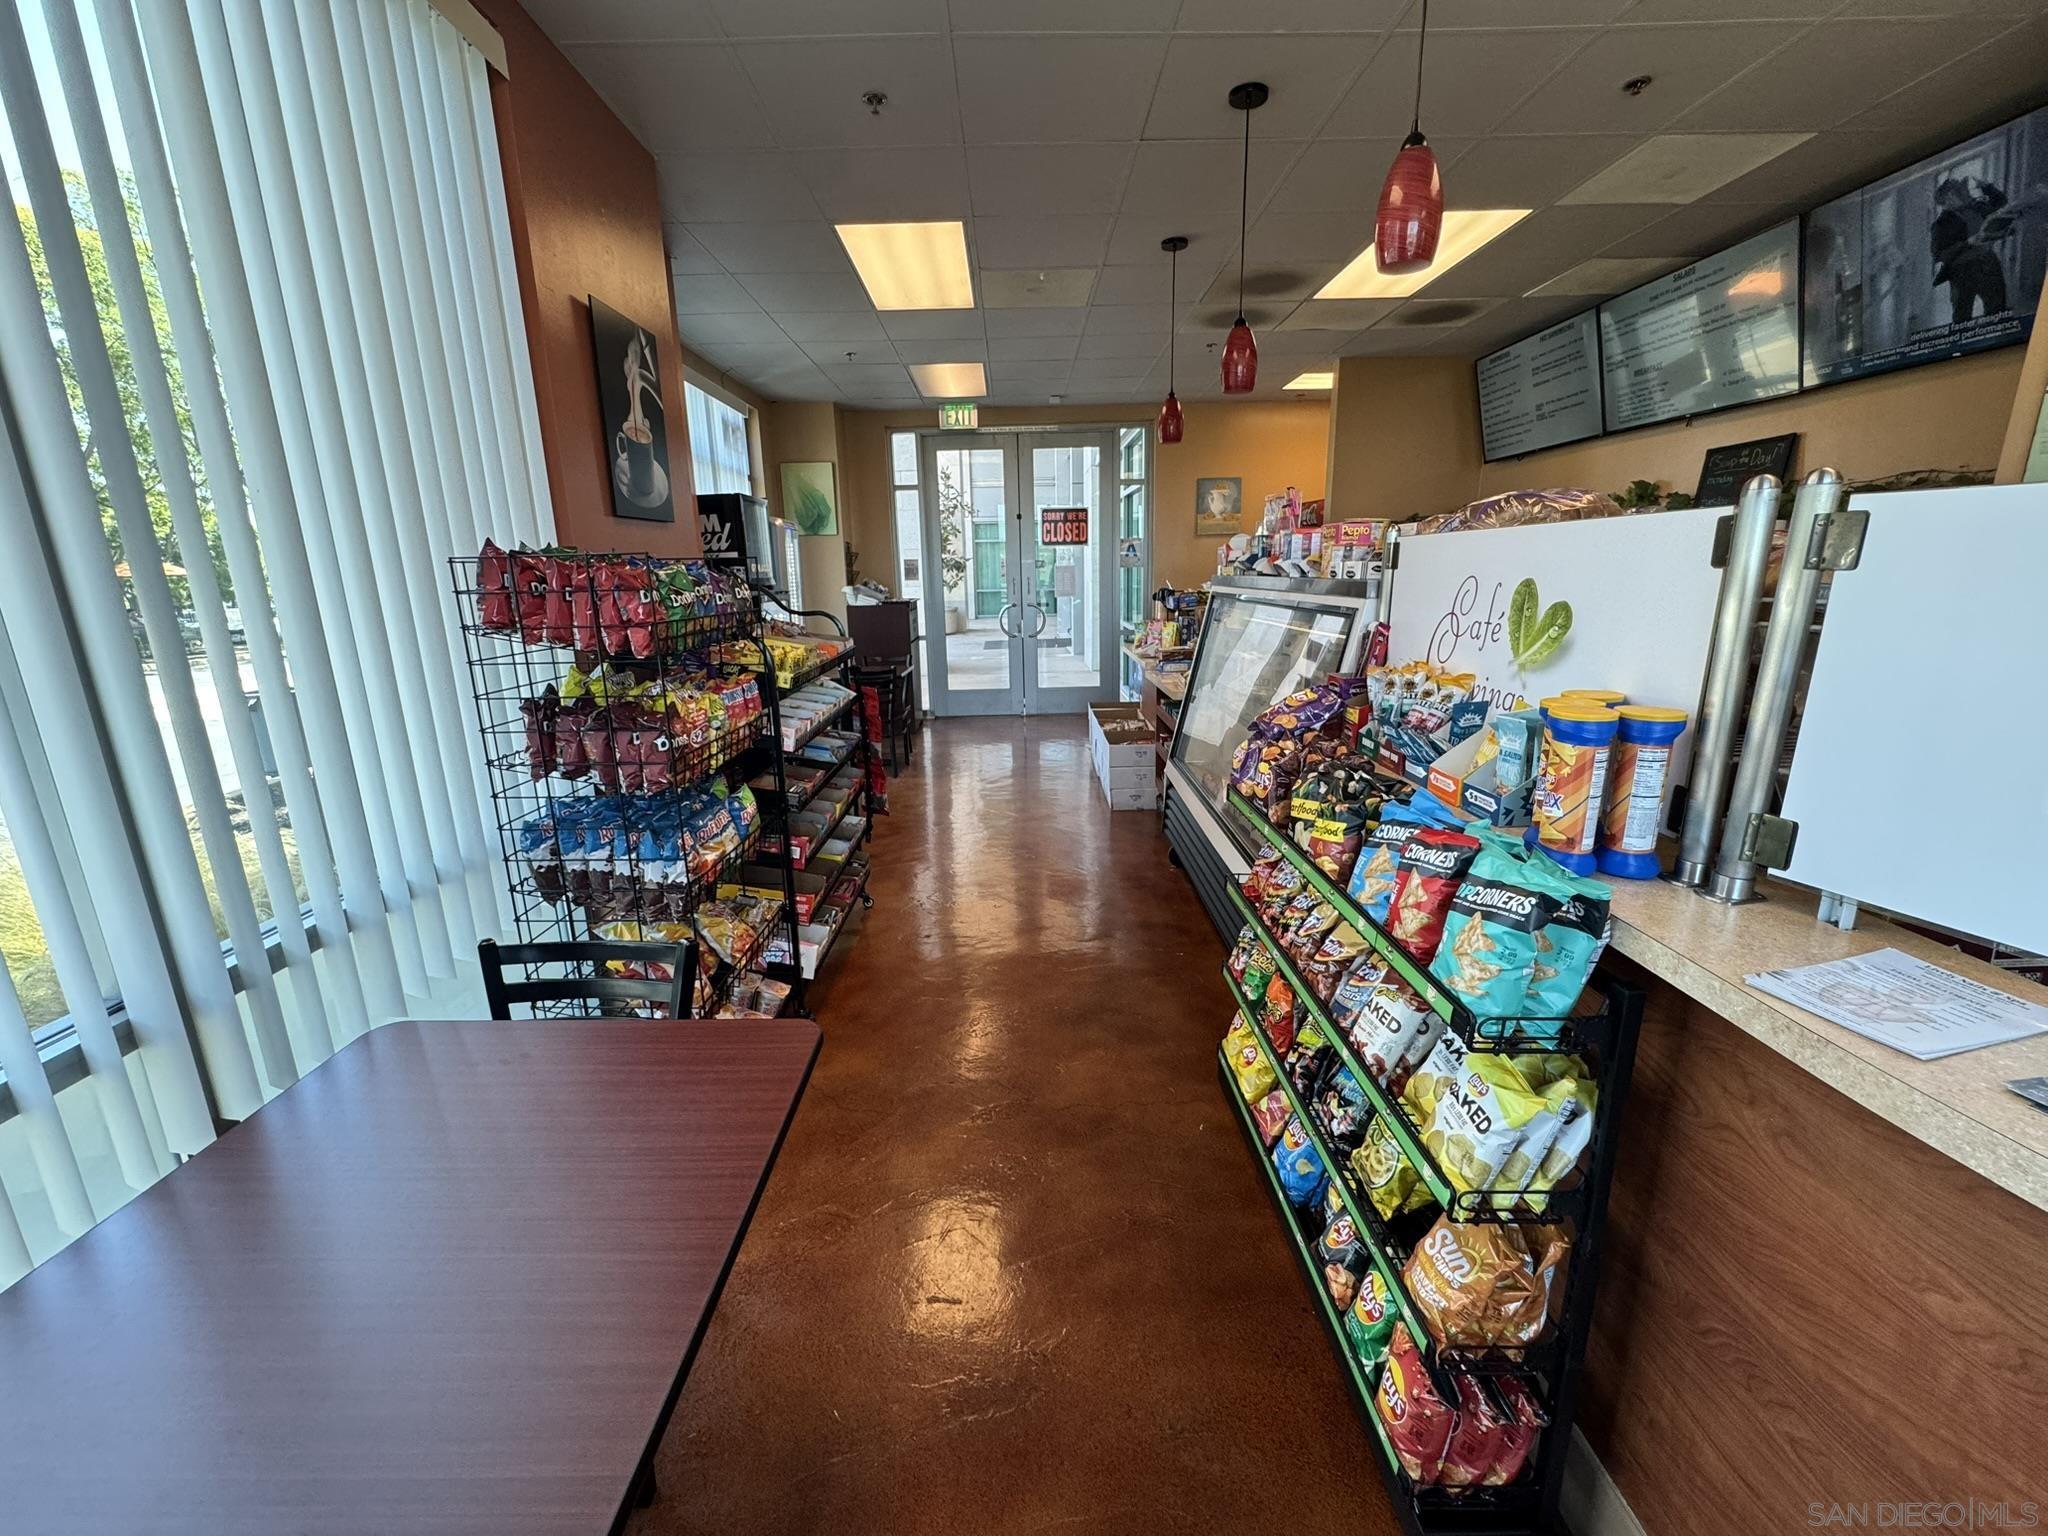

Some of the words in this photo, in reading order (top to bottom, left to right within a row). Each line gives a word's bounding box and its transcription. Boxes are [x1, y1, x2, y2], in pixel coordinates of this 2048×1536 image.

[1910, 326, 1950, 342] delivering
[1951, 318, 1976, 332] faster
[1977, 309, 2014, 325] insights
[1961, 319, 2020, 341] performance
[945, 409, 973, 427] EXIT
[1043, 511, 1064, 521] SORRY
[1043, 521, 1087, 543] CLOSED
[1343, 525, 1370, 537] Pepto
[1427, 575, 1505, 664] Café
[1456, 882, 1537, 915] OPCORNERS
[1365, 997, 1402, 1034] AKED
[1424, 1228, 1471, 1283] Sun
